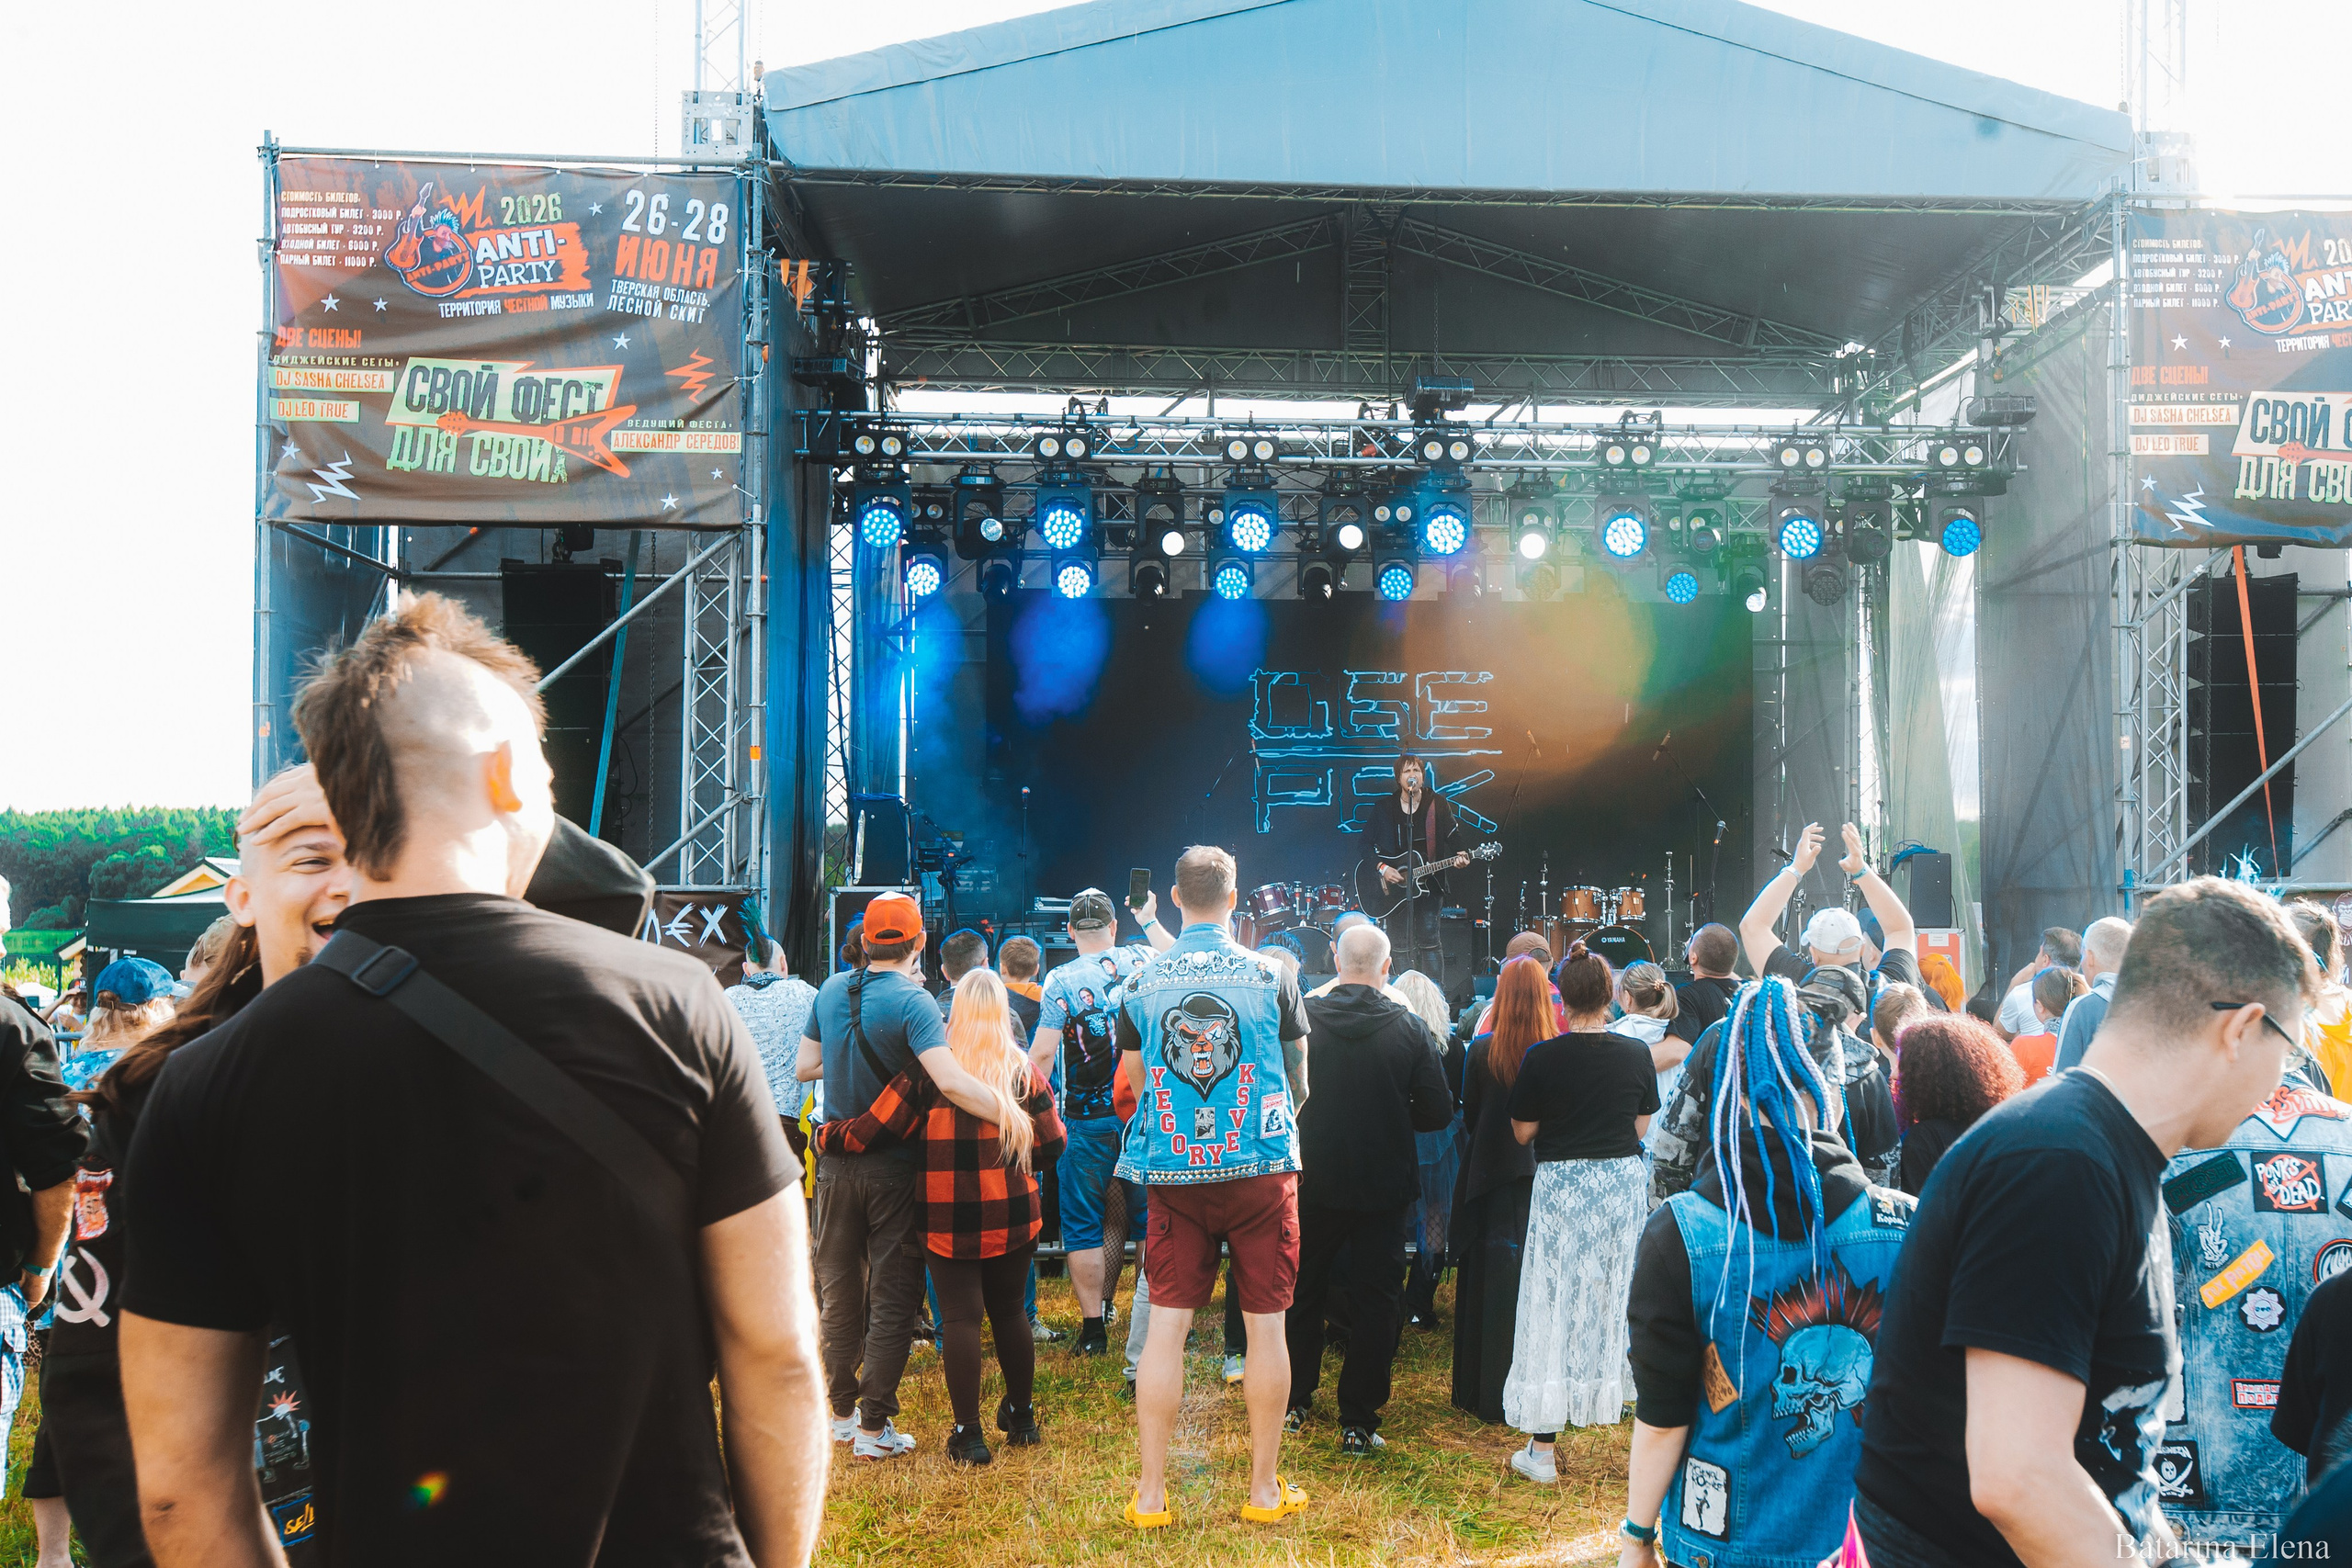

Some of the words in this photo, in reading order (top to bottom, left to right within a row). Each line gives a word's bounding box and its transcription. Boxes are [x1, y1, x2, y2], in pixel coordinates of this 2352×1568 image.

[281, 207, 337, 219] ПОДРОСТКОВЫЙ
[340, 209, 363, 220] БИЛЕТ
[372, 209, 393, 220] 3000
[501, 193, 562, 226] 2026
[282, 222, 328, 234] АВТОБУСНЫЙ
[331, 224, 345, 234] ТУР
[352, 224, 373, 235] 3200
[281, 238, 313, 250] ВХОДНОЙ
[316, 240, 340, 250] БИЛЕТ
[348, 241, 369, 251] 6000
[476, 229, 567, 264] ANTI-
[2324, 238, 2352, 266] 20
[280, 254, 311, 265] ПАРНЫЙ
[312, 255, 336, 266] БИЛЕТ
[345, 256, 367, 267] 11000
[406, 250, 471, 282] ANTI-PARTY
[615, 234, 718, 290] ИЮНЯ
[2132, 253, 2184, 264] ПОДРОСТКОВЫЙ
[2186, 254, 2206, 264] БИЛЕТ
[2213, 254, 2232, 265] 3000
[478, 260, 556, 288] PARTY
[2133, 267, 2176, 278] АВТОБУСНЫЙ
[2178, 268, 2190, 278] ТУР
[2198, 269, 2216, 278] 3200
[611, 279, 660, 299] ТВЕРСКАЯ
[2165, 284, 2187, 292] БИЛЕТ
[2195, 284, 2212, 293] 6000
[438, 299, 502, 319] ТЕРРИТОРИЯ
[503, 295, 548, 314] ЧЕСТНОЙ
[550, 293, 594, 310] МУЗЫКИ
[606, 295, 663, 319] ЛЕСНОЙ
[669, 304, 706, 324] СКИТ
[2133, 297, 2160, 308] ПАРНЫЙ
[2163, 298, 2184, 308] БИЛЕТ
[2191, 298, 2211, 308] 11000
[2245, 291, 2300, 321] ANTI-PARTY
[276, 326, 304, 348] ДВЕ
[309, 328, 361, 349] СЦЕНЫ!
[2275, 334, 2330, 353] ТЕРРИТОРИЯ
[273, 355, 356, 367] ДИДЖЕЙСКИЕ
[276, 370, 291, 387] DJ
[295, 371, 332, 388] SASHA
[335, 372, 385, 389] CHELSEA
[2132, 366, 2156, 386] ДВЕ
[2160, 366, 2209, 386] СЦЕНЫ!
[405, 365, 499, 420] СВОЙ
[512, 377, 604, 425] ФЕСТ
[2131, 392, 2205, 402] ДИДЖЕЙСКИЕ
[277, 401, 292, 417] DJ
[295, 401, 315, 418] LEO
[321, 401, 349, 419] TRUE
[2133, 408, 2147, 423] DJ
[2151, 408, 2183, 423] SASHA
[2187, 408, 2231, 423] CHELSEA
[628, 419, 684, 429] ВЕДУЩИЙ
[2250, 397, 2331, 448] СВОЙ
[614, 433, 681, 449] АЛЕКСАНДР
[686, 434, 740, 450] СЕРЕДОВ!
[2135, 436, 2149, 451] DJ
[2152, 436, 2170, 451] LEO
[2175, 436, 2199, 451] TRUE
[386, 425, 458, 473] ДЛЯ
[469, 436, 568, 484] СВОИХ
[2234, 457, 2297, 501] ДЛЯ
[2254, 1157, 2301, 1182] PUNKS
